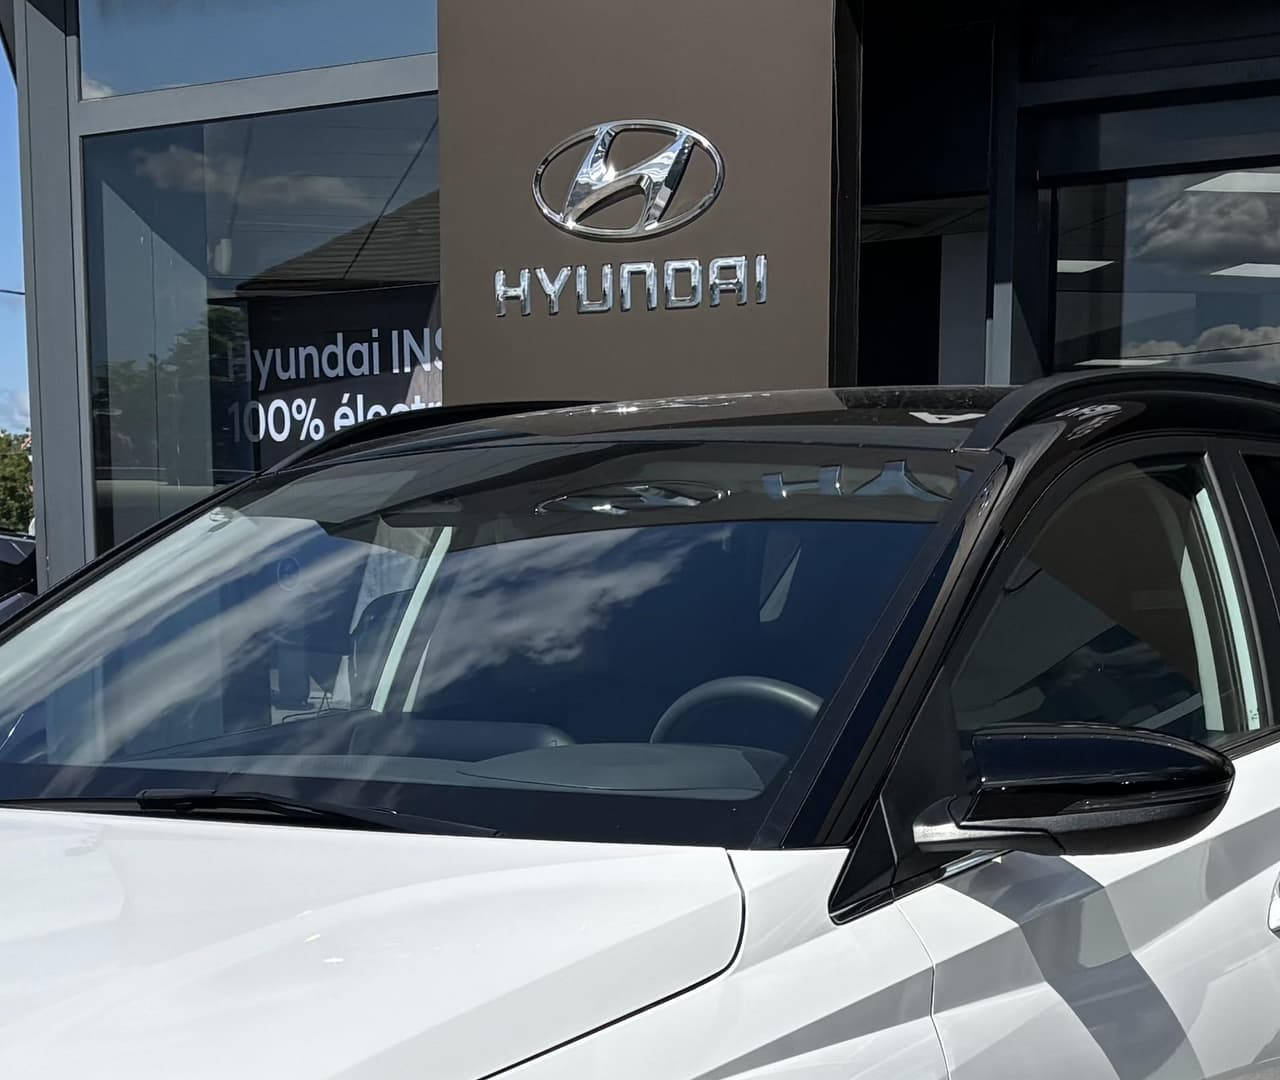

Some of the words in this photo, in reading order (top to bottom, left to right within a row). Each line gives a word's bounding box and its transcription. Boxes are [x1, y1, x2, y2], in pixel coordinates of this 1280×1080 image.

[495, 254, 769, 317] HYUNDAI
[228, 328, 380, 391] Hyundai
[227, 398, 326, 443] 100%
